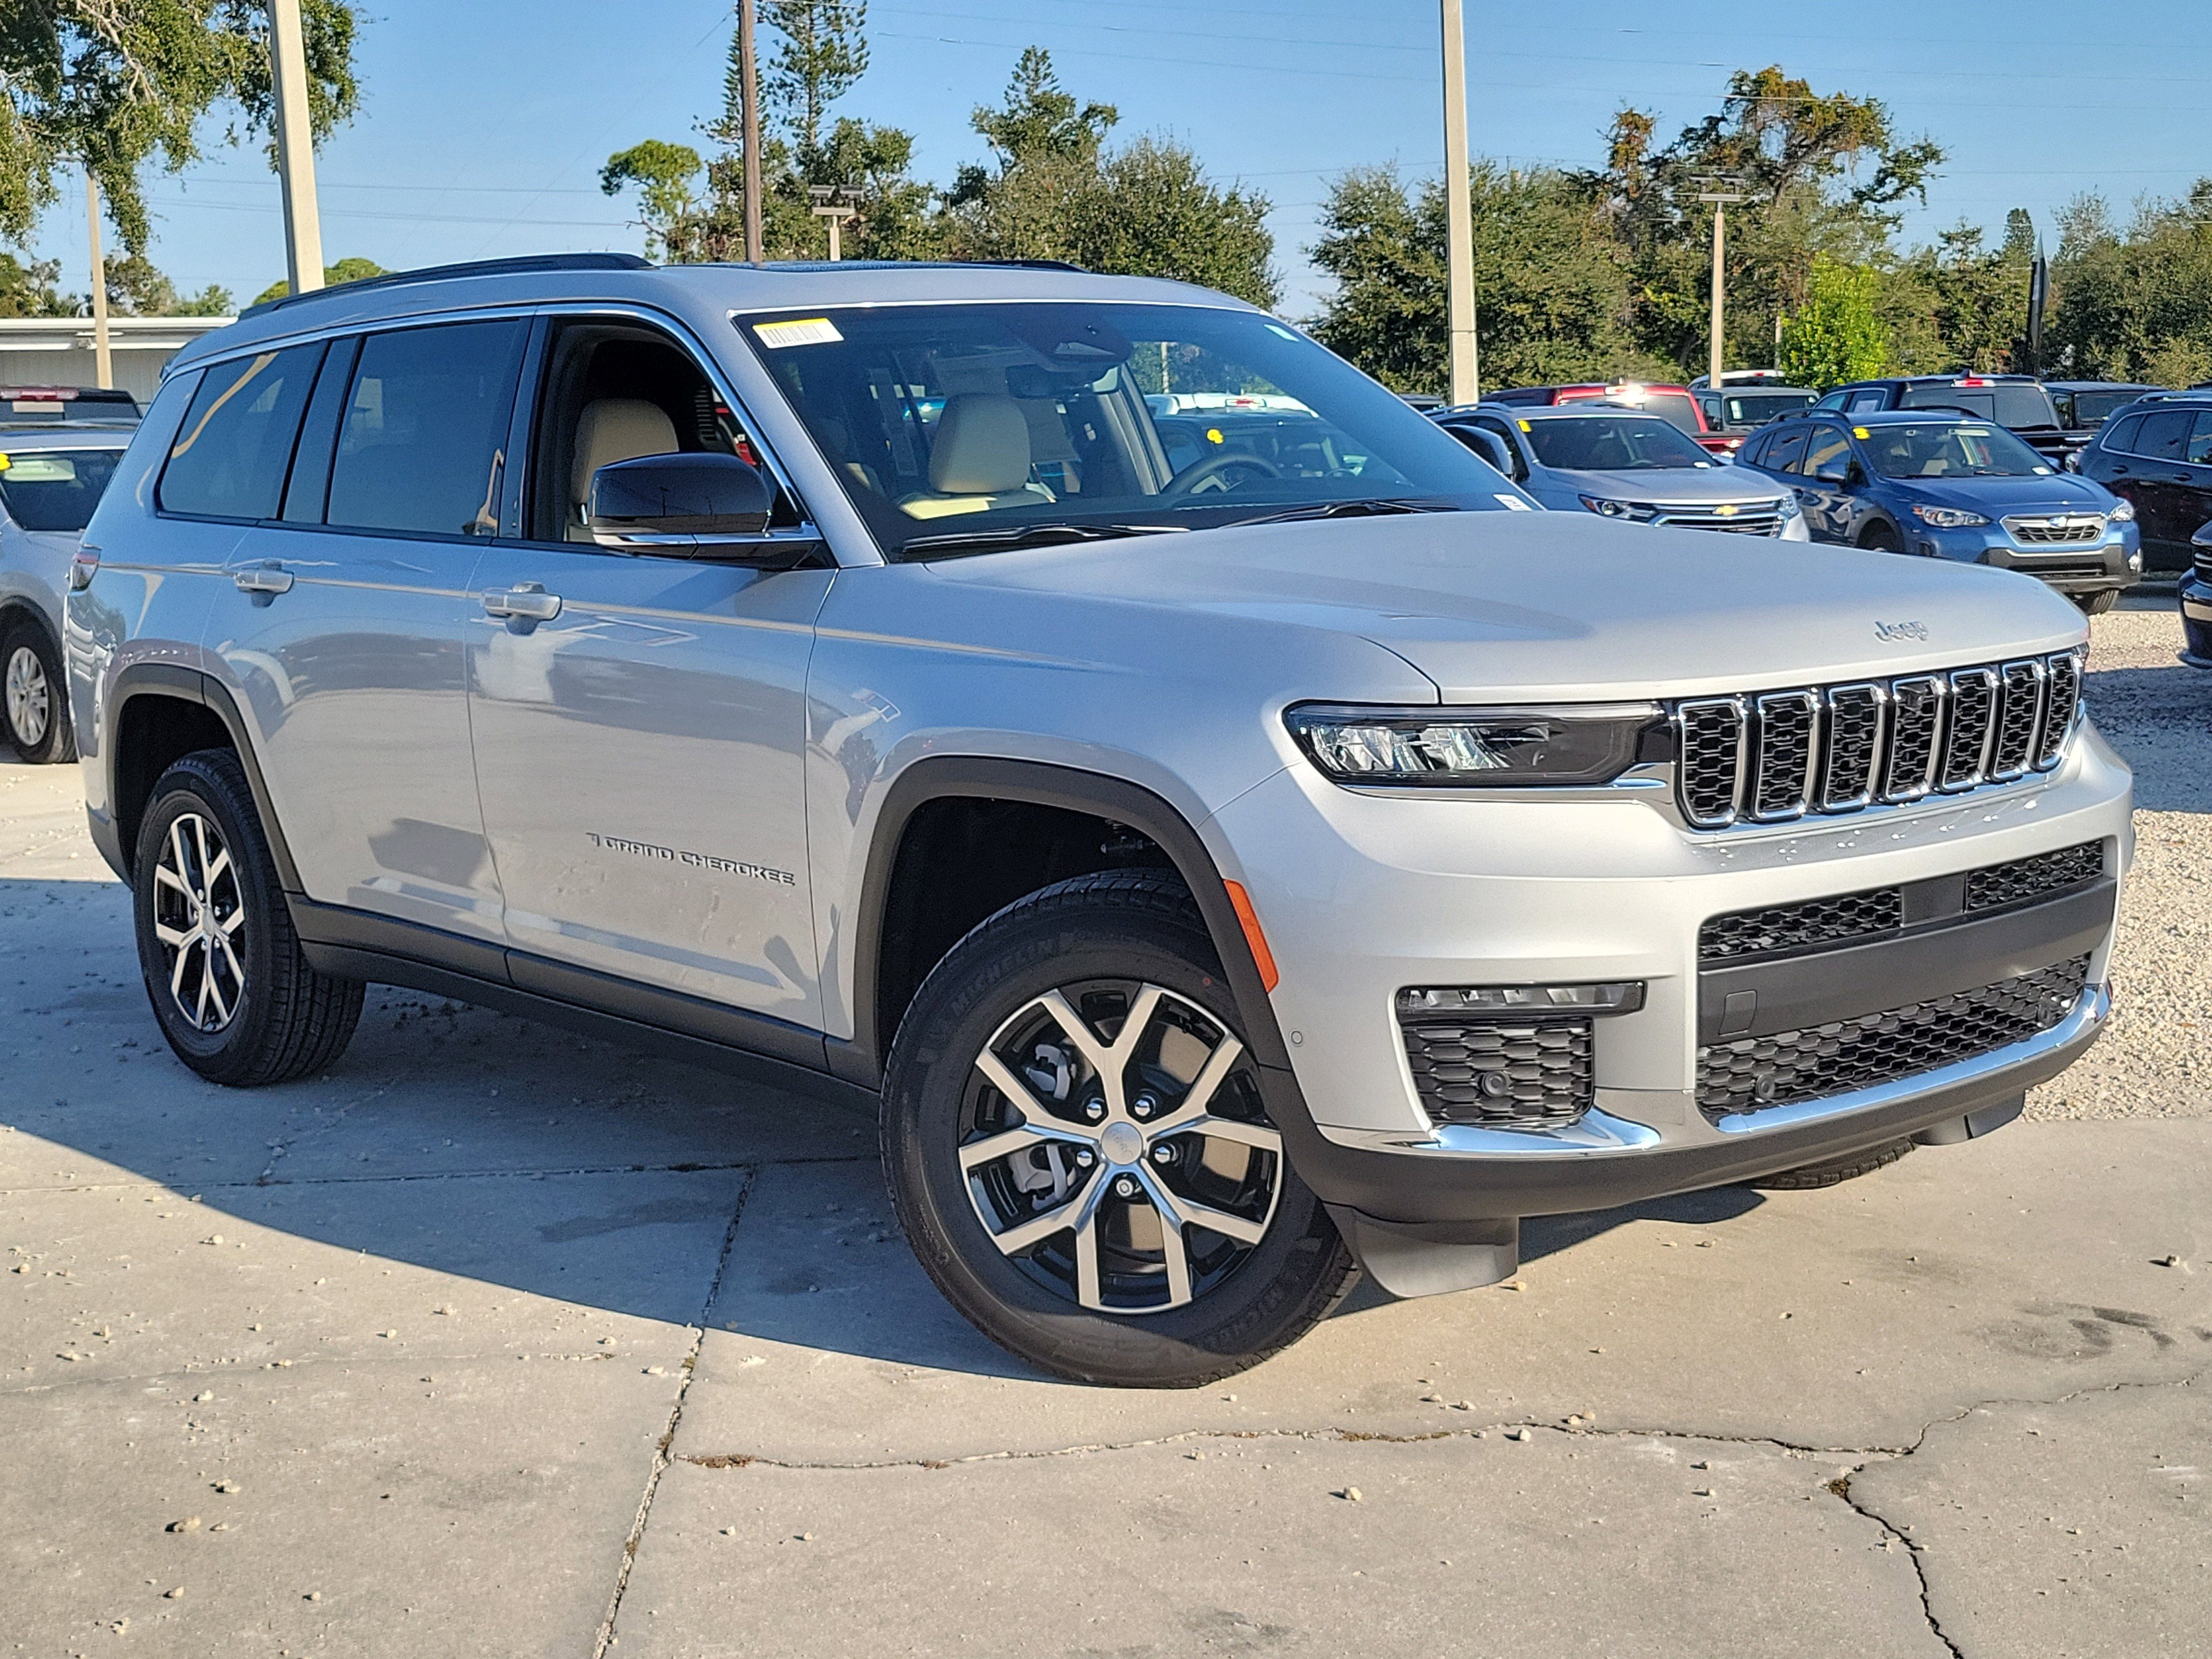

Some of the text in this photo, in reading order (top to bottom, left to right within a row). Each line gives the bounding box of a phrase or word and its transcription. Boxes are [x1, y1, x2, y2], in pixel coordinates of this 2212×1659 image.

[1875, 621, 1928, 642] Jeep
[605, 836, 796, 887] GRAND CHEROKEE
